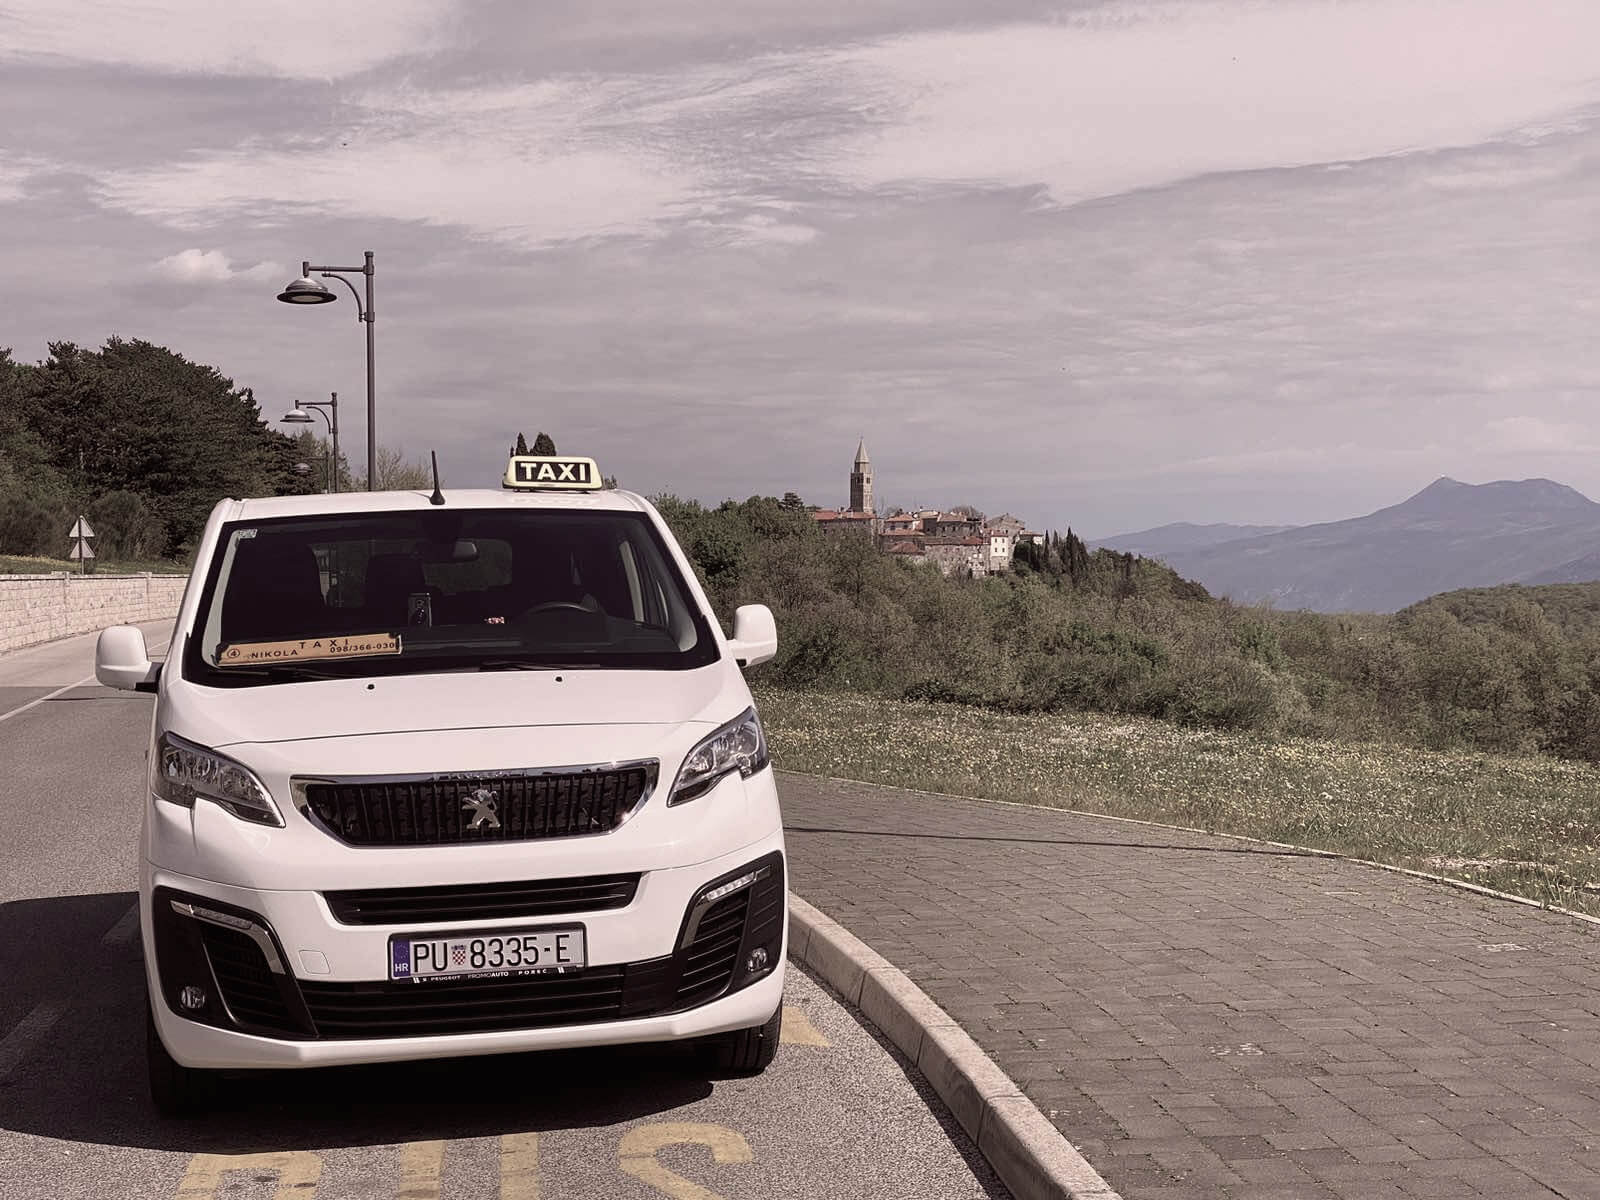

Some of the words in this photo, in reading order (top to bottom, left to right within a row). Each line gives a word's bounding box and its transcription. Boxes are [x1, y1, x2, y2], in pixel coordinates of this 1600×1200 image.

[520, 463, 586, 481] TAXI
[299, 639, 349, 649] TAXI
[252, 649, 298, 658] NIKOLA
[413, 942, 448, 972] PU
[470, 934, 570, 968] 8335-E
[395, 963, 409, 973] HR
